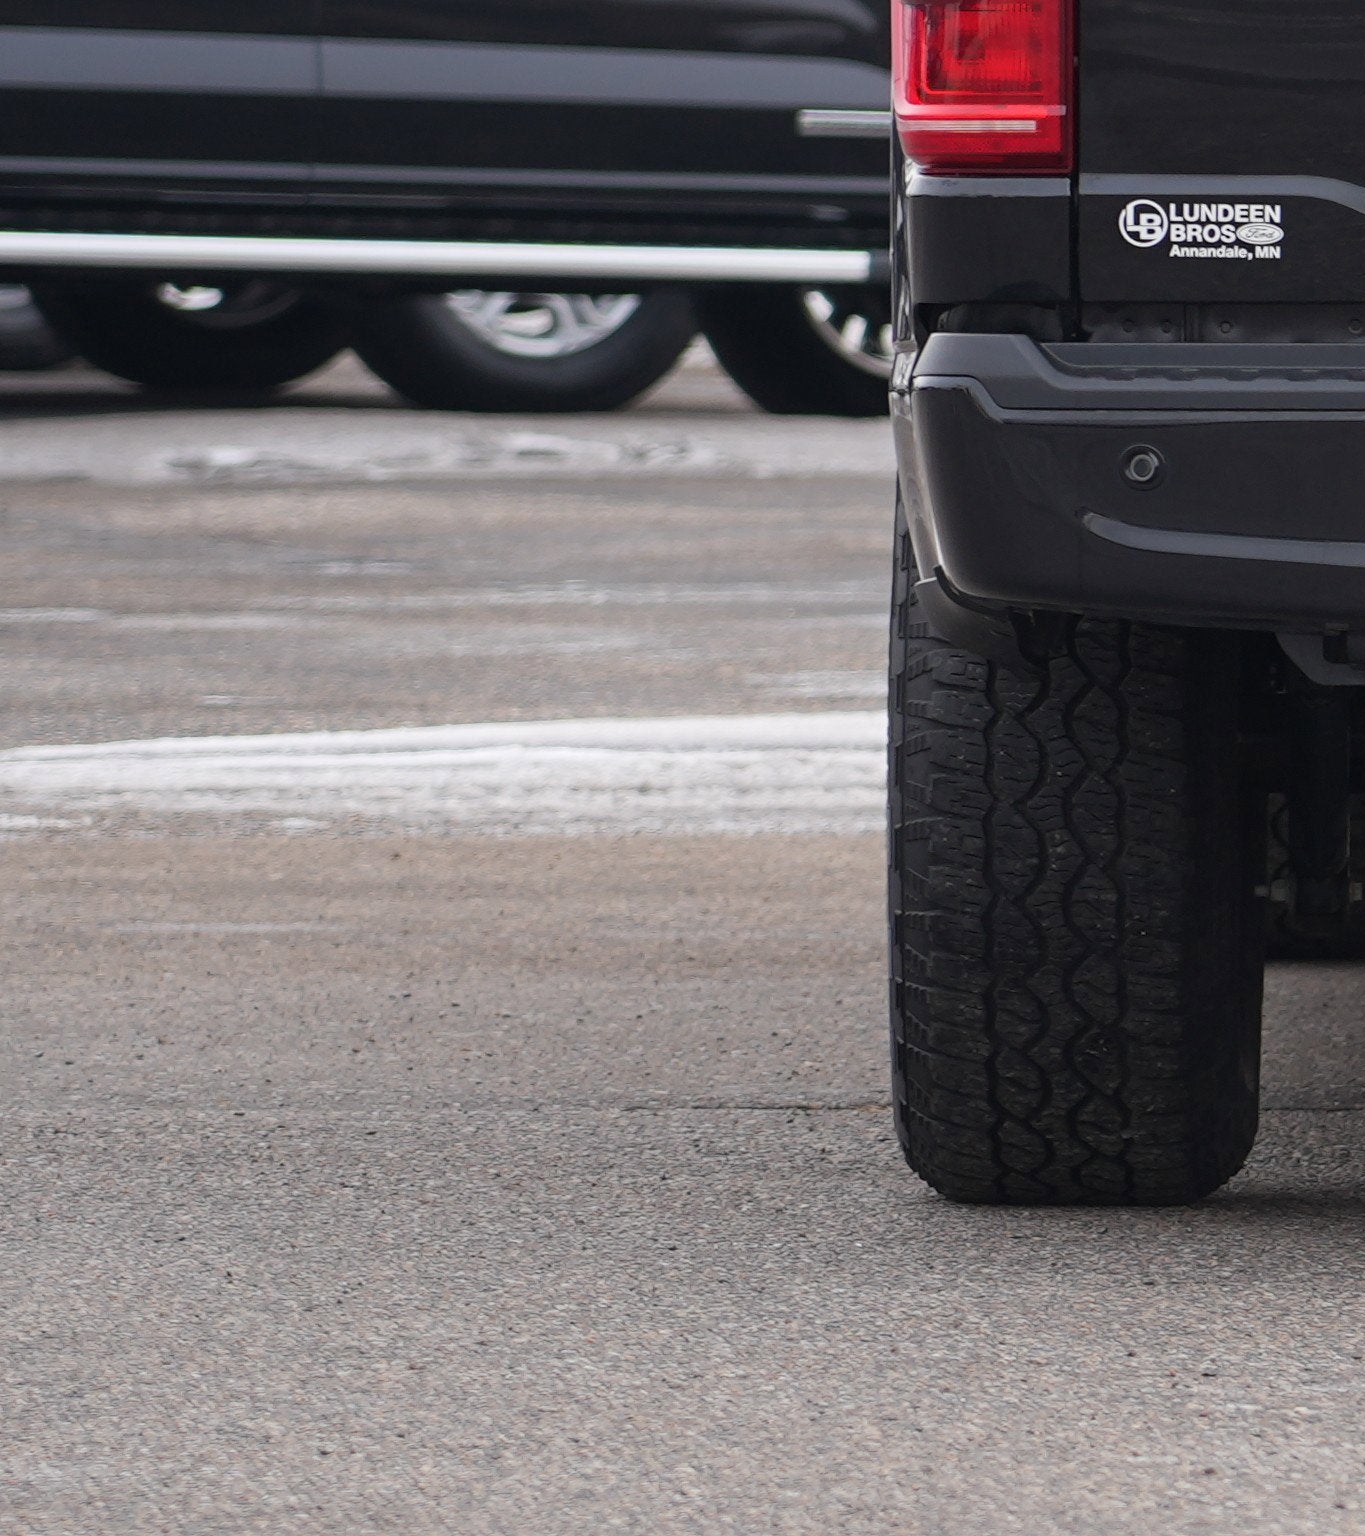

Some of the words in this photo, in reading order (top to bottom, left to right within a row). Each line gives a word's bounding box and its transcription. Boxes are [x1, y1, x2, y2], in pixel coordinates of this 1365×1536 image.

[1169, 203, 1282, 223] LUNDEEN
[1169, 224, 1237, 243] BROS
[1169, 245, 1253, 261] Annandale,
[1255, 245, 1282, 259] MN
